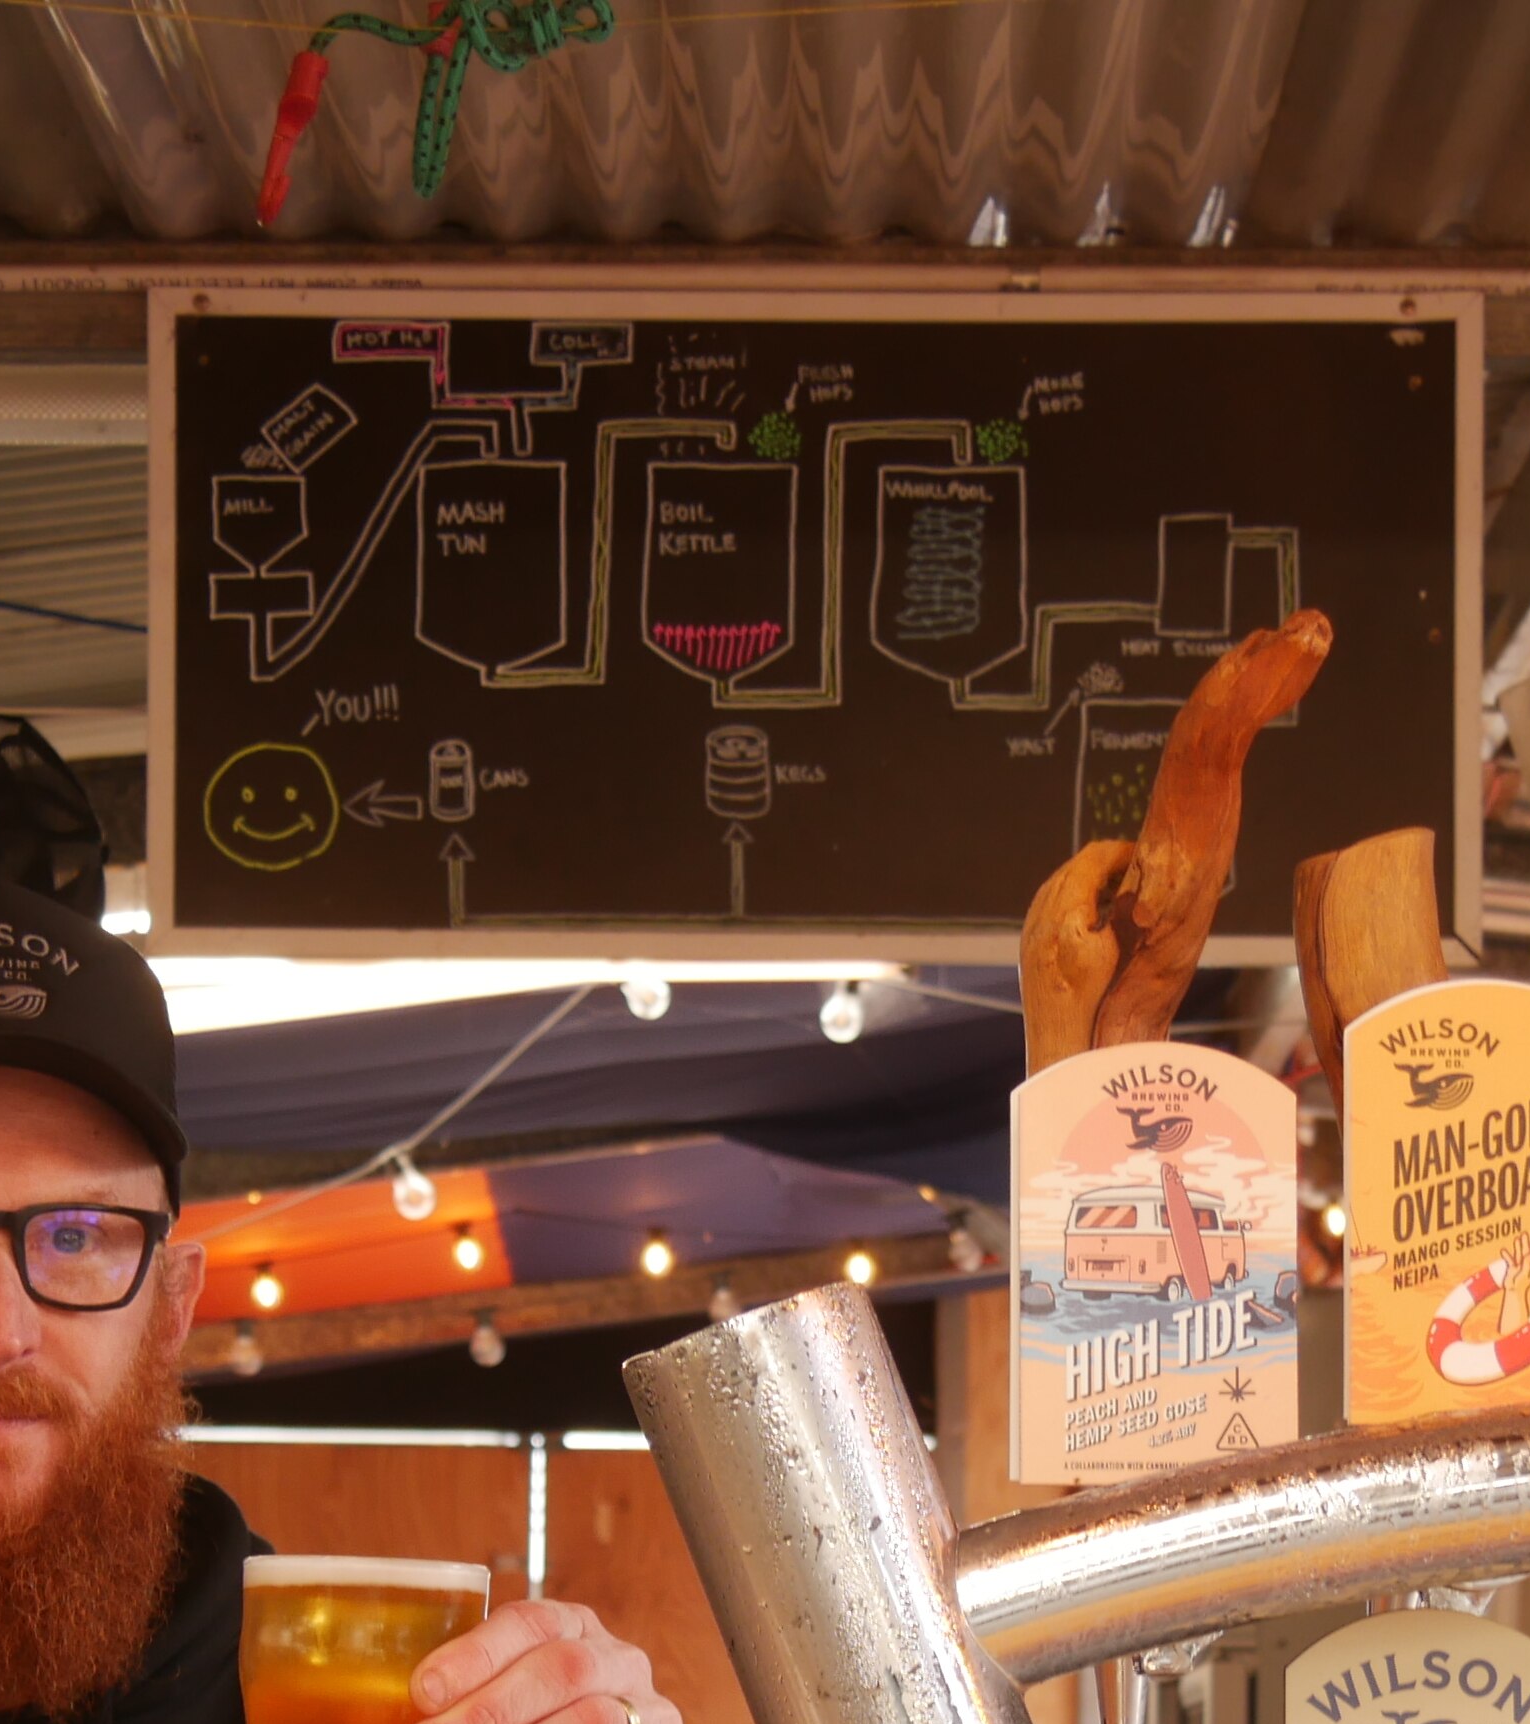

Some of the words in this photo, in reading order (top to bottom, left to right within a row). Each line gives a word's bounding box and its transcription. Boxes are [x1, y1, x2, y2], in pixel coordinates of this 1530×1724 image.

[223, 496, 275, 517] MILL
[437, 501, 506, 526] MASH
[659, 501, 714, 524] BOIL
[437, 532, 487, 556] TUN
[659, 533, 737, 556] KETTLE
[315, 683, 401, 725] YOU!!!
[479, 767, 529, 790] CANS
[775, 762, 827, 785] KEGS
[1379, 1018, 1501, 1058] WILSON
[1410, 1047, 1471, 1058] BREWING
[1102, 1063, 1219, 1102] WILSON
[1131, 1092, 1190, 1102] BREWING
[1392, 1237, 1451, 1272] MANGO
[1454, 1215, 1523, 1253] SESSION
[1392, 1262, 1440, 1293] NEIPA
[1066, 1318, 1161, 1402] HIGH
[1173, 1290, 1258, 1368] TIDE
[1065, 1397, 1118, 1430] PEACH
[1122, 1387, 1158, 1414] AND
[1064, 1425, 1113, 1454] HEMP
[1117, 1406, 1160, 1439] SEED
[1164, 1392, 1208, 1422] GOSE
